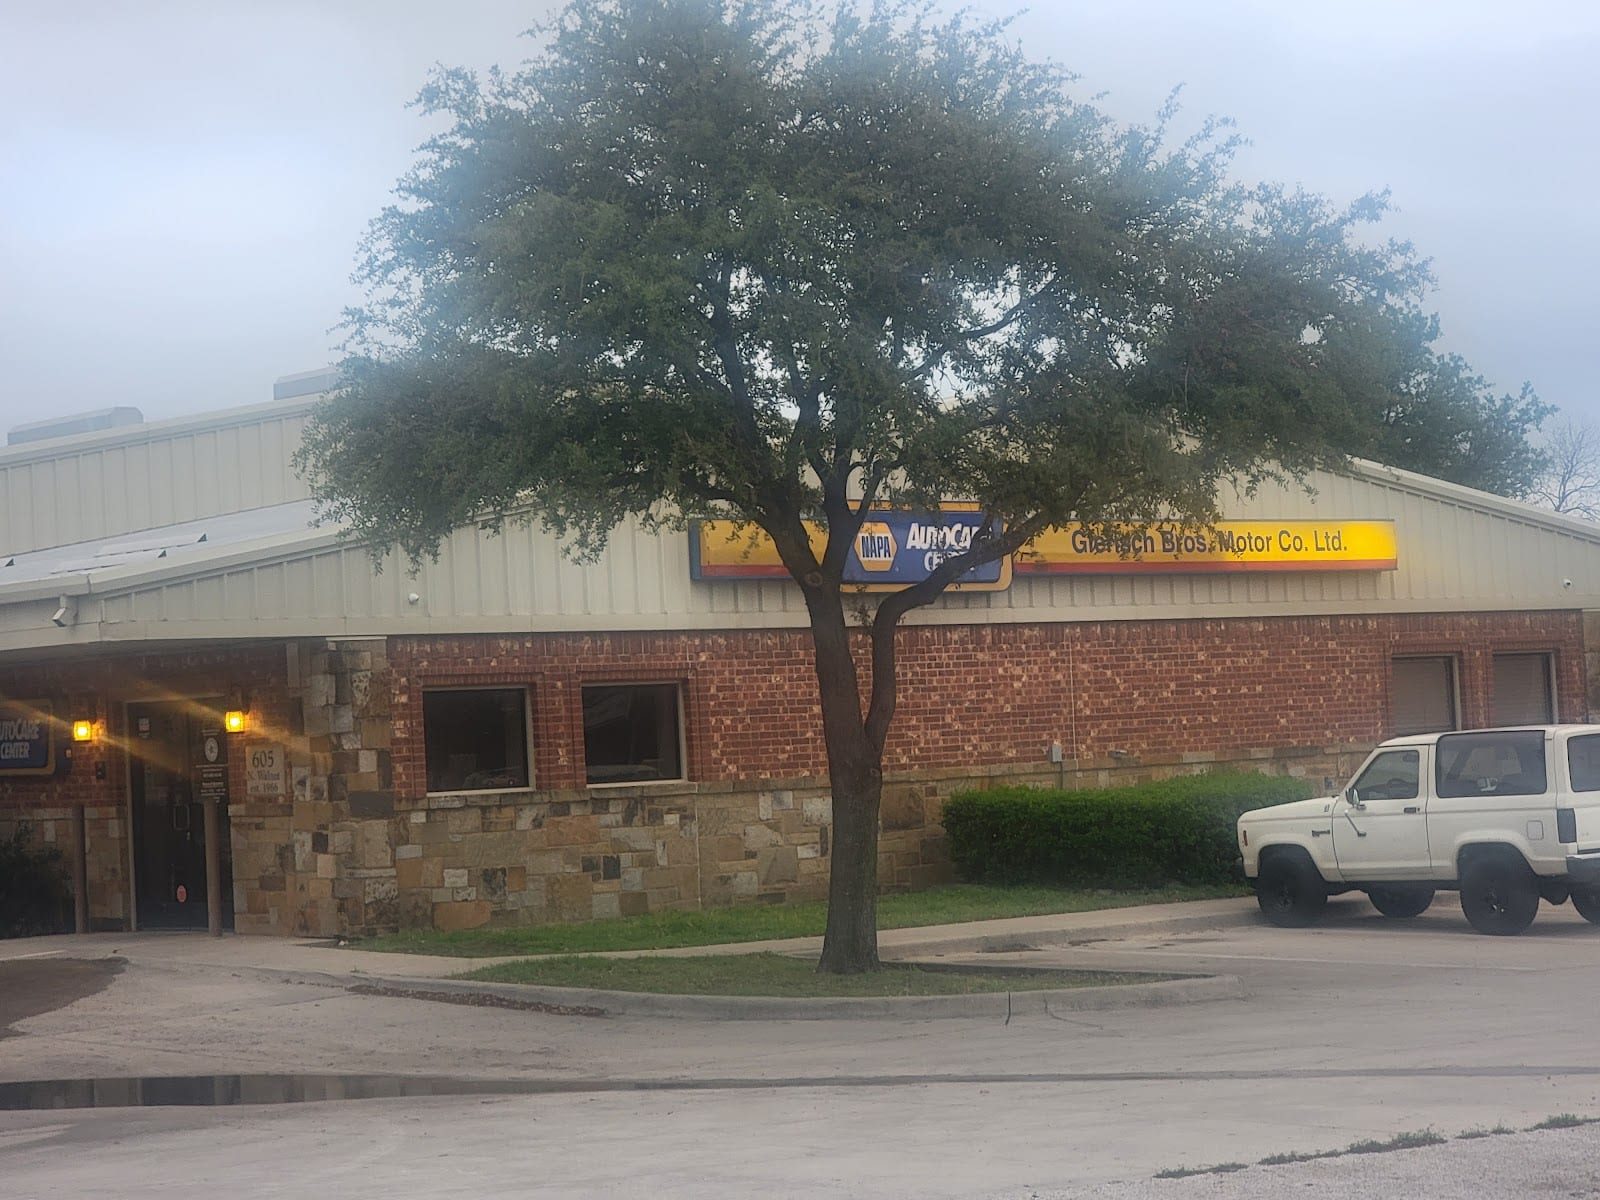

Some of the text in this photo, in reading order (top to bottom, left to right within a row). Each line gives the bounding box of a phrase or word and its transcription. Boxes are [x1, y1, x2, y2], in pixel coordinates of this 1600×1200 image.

[861, 535, 891, 558] NAPA
[906, 522, 992, 550] AUTOCA
[1217, 530, 1272, 553] Motor
[1278, 529, 1308, 552] Co.
[1314, 530, 1347, 552] Ltd.
[0, 718, 40, 741] UTOCARE
[0, 742, 30, 759] CENTER
[252, 750, 274, 768] 605
